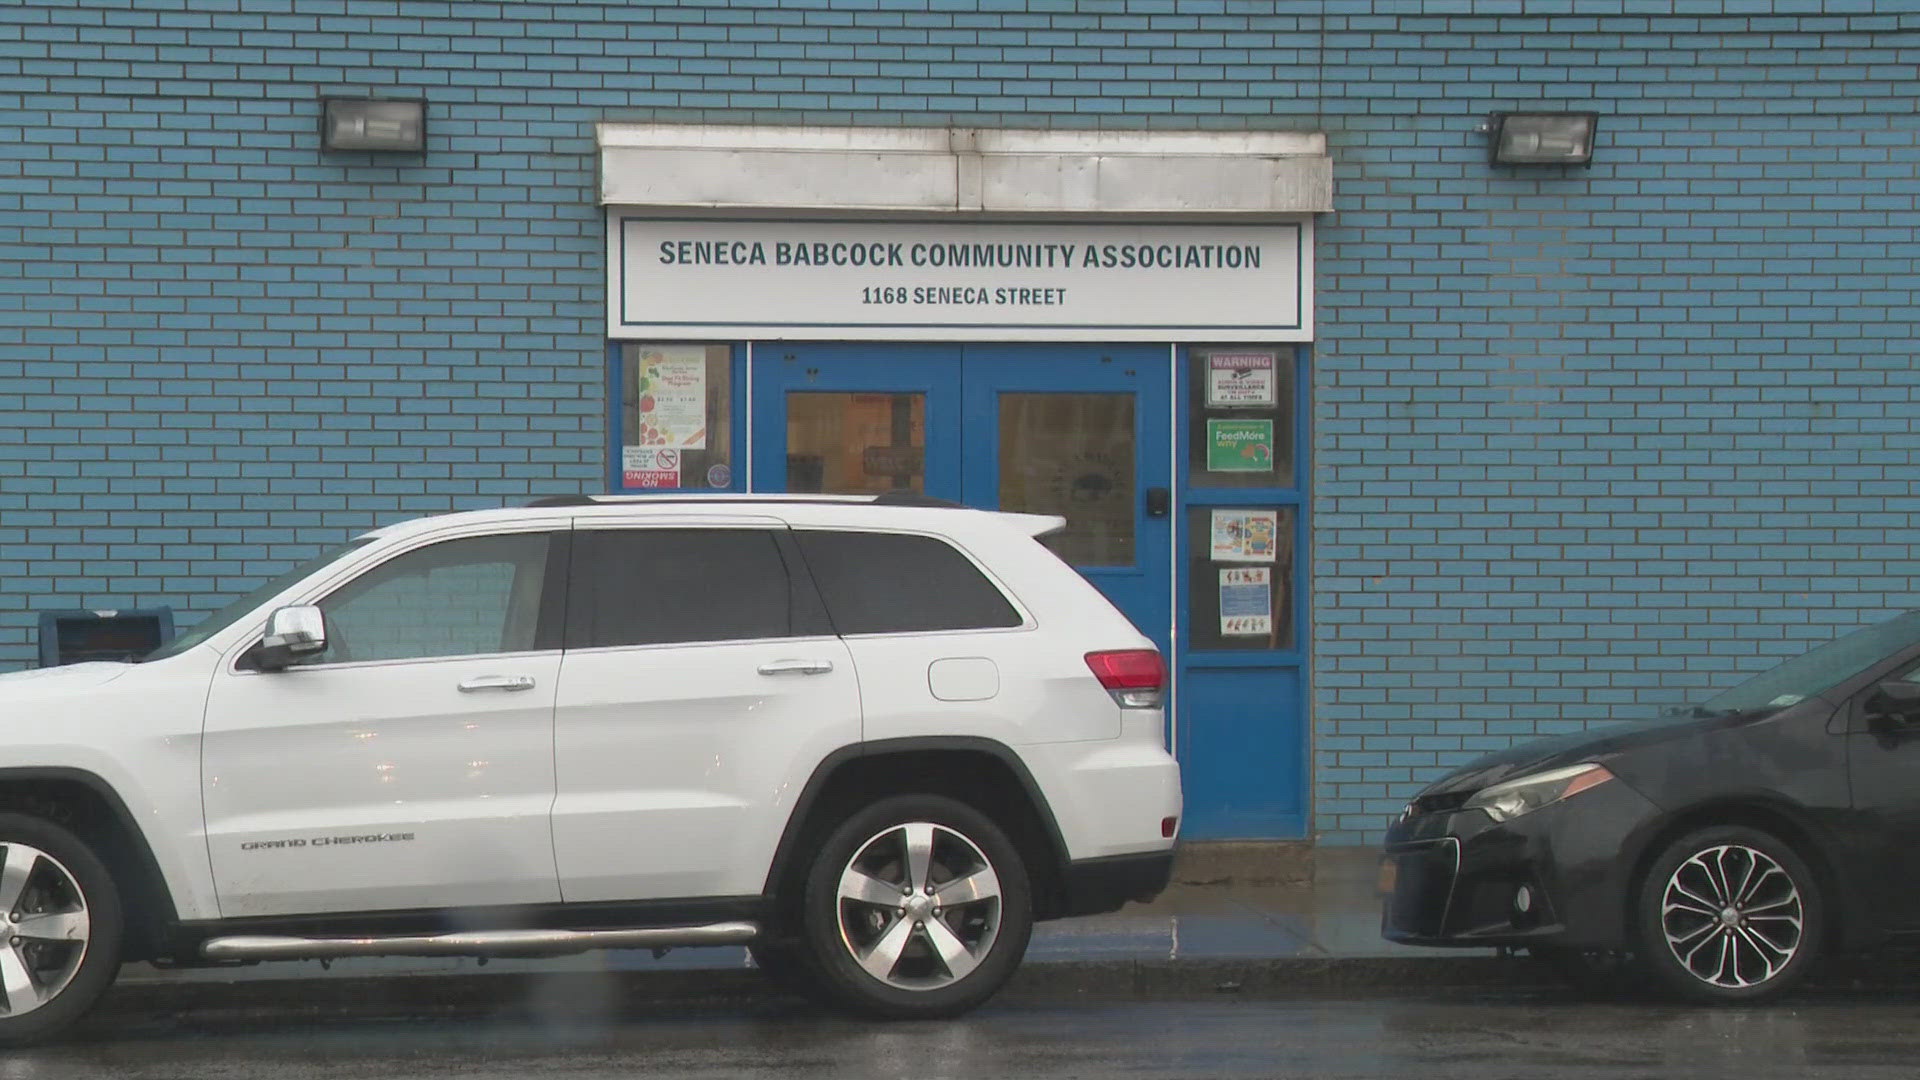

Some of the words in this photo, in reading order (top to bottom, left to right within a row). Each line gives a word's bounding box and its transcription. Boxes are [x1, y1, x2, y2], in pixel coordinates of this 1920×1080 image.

[659, 241, 766, 265] SENECA
[775, 242, 904, 267] BABCOCK
[911, 243, 1075, 268] COMMUNITY
[1082, 244, 1261, 269] ASSOCIATION
[862, 287, 908, 304] 1168
[913, 287, 989, 305] SENECA
[995, 288, 1067, 305] STREET
[1213, 357, 1270, 368] WARNING
[1216, 430, 1265, 440] FeedMore
[625, 471, 675, 480] SMOKING
[642, 480, 658, 488] NO
[241, 838, 307, 850] GRAND
[311, 832, 415, 846] CHEROKEE
